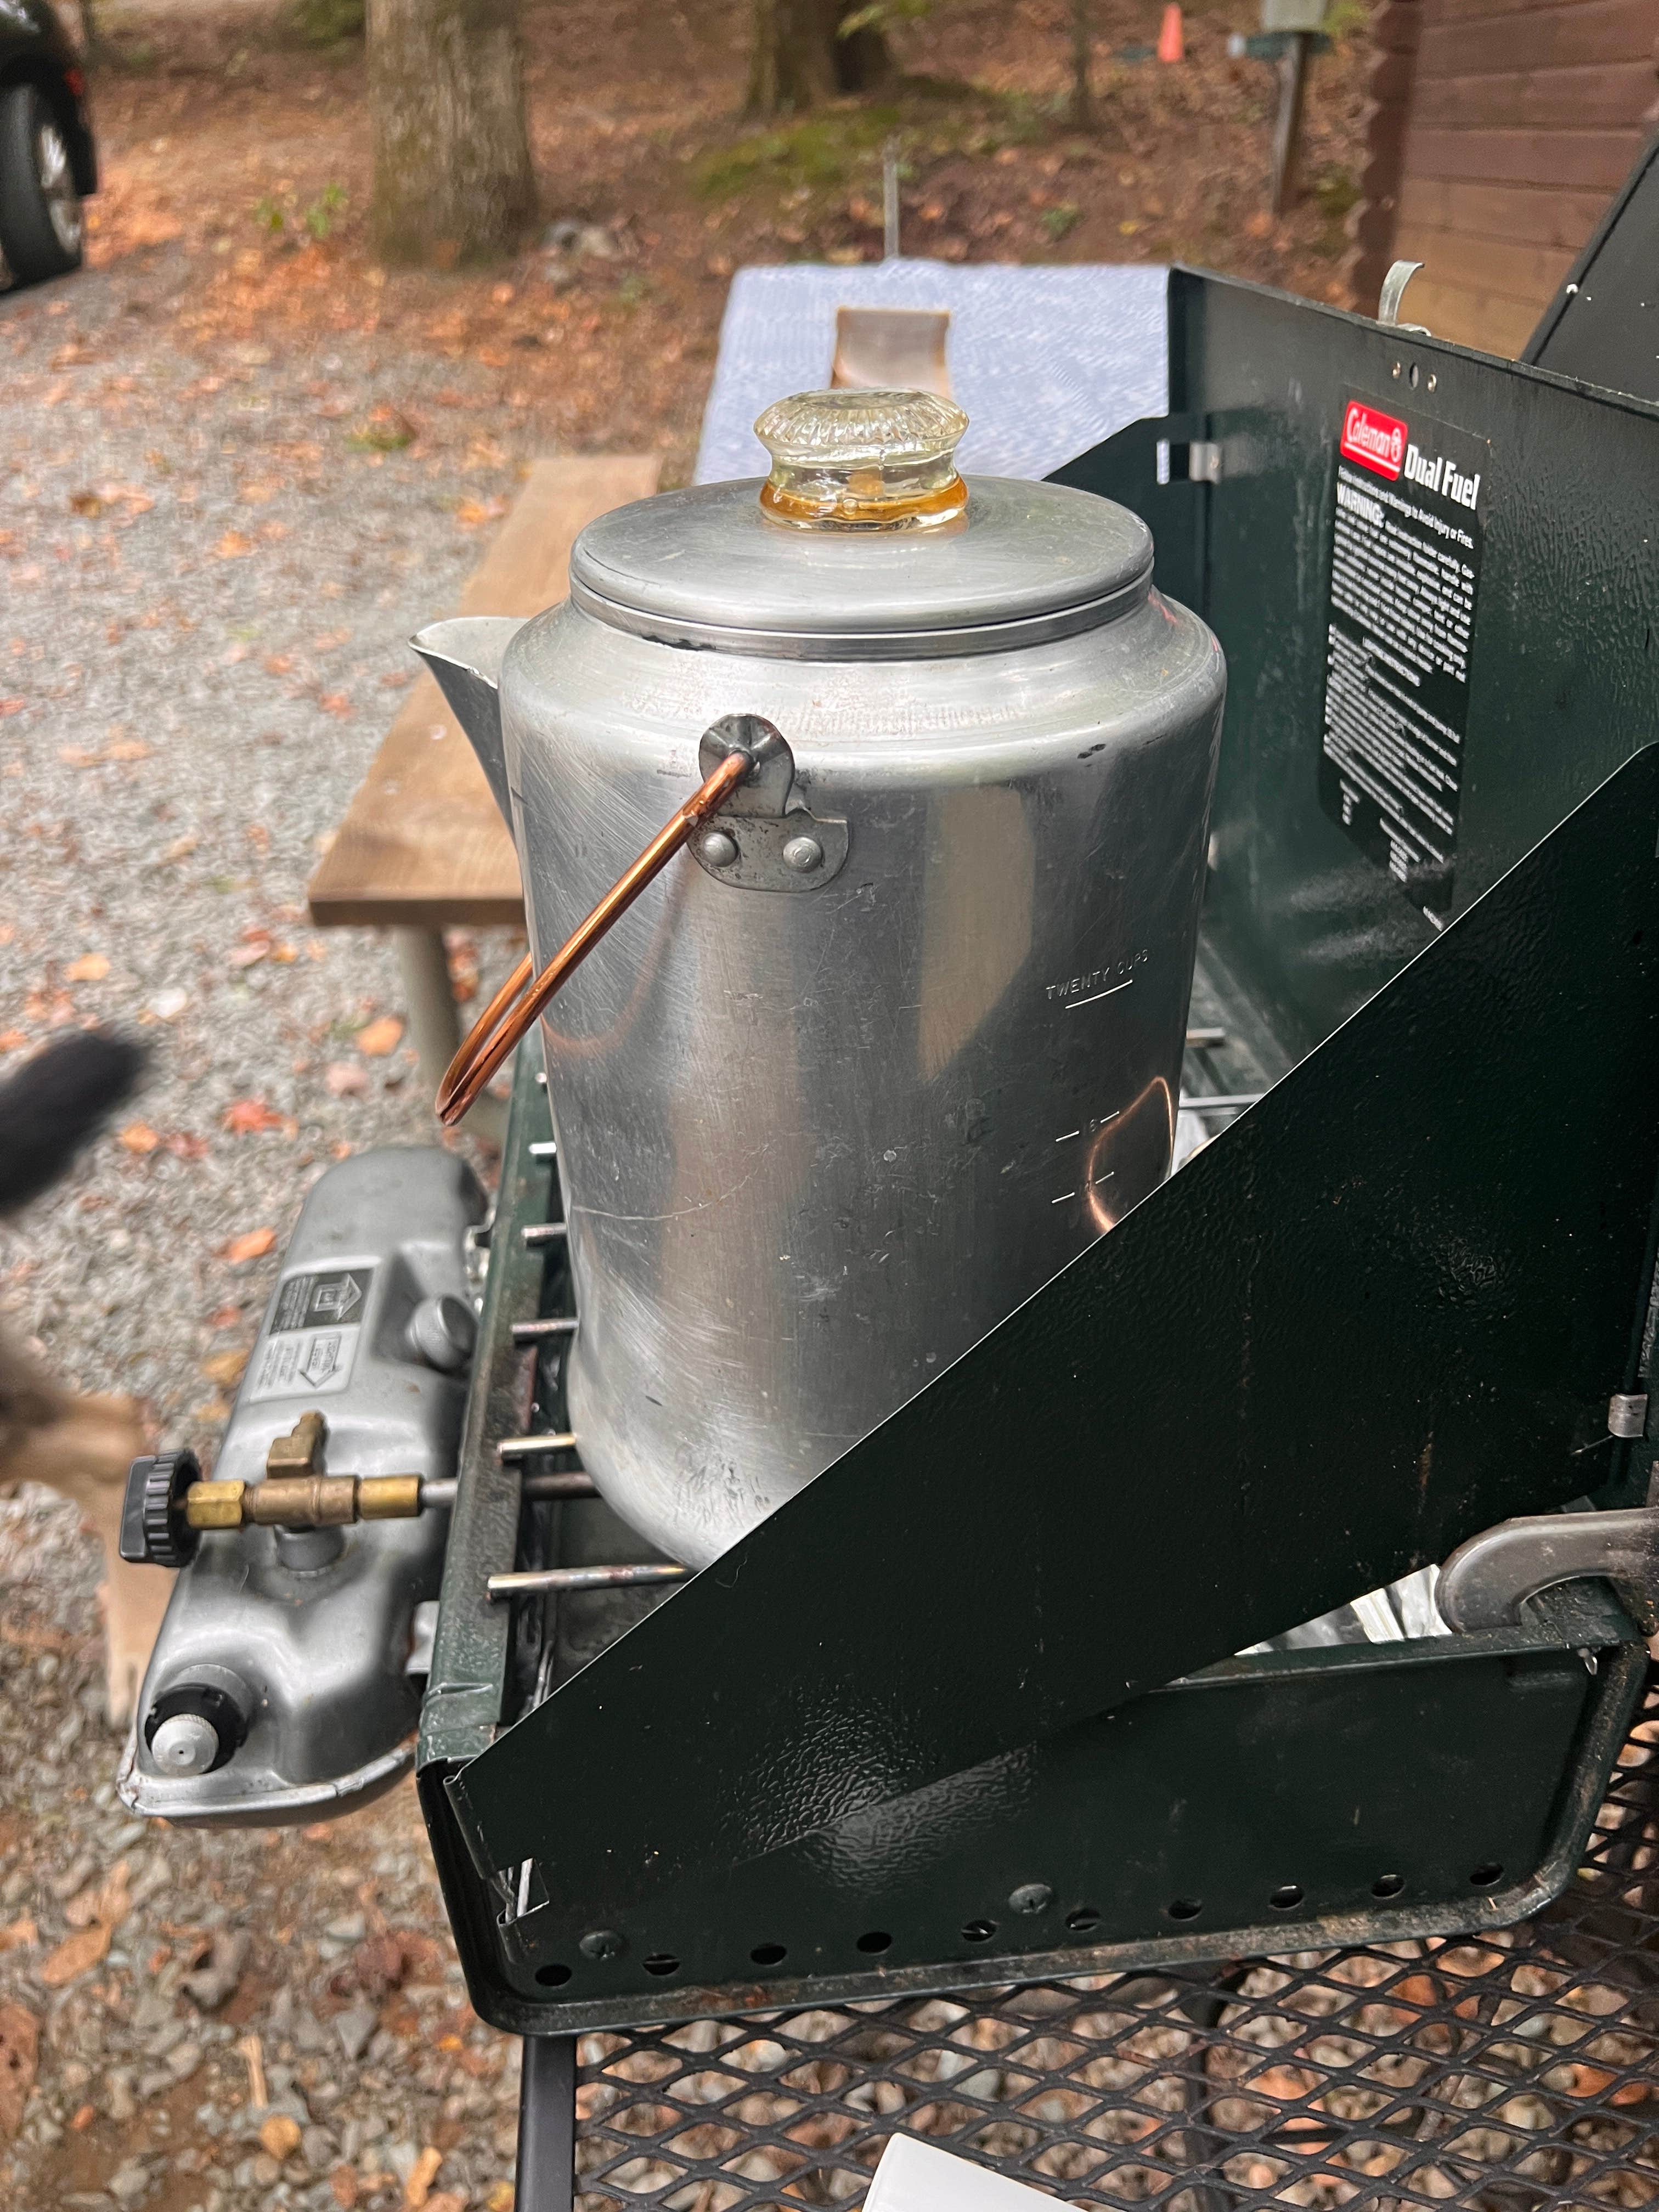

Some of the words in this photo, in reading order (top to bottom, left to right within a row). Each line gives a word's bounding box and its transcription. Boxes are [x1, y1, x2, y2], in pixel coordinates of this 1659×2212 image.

[1347, 408, 1392, 458] Coleman
[1404, 444, 1443, 492] Dual
[1442, 460, 1480, 510] Fuel
[1046, 967, 1110, 1000] TWENTY
[1118, 949, 1148, 975] CUPS
